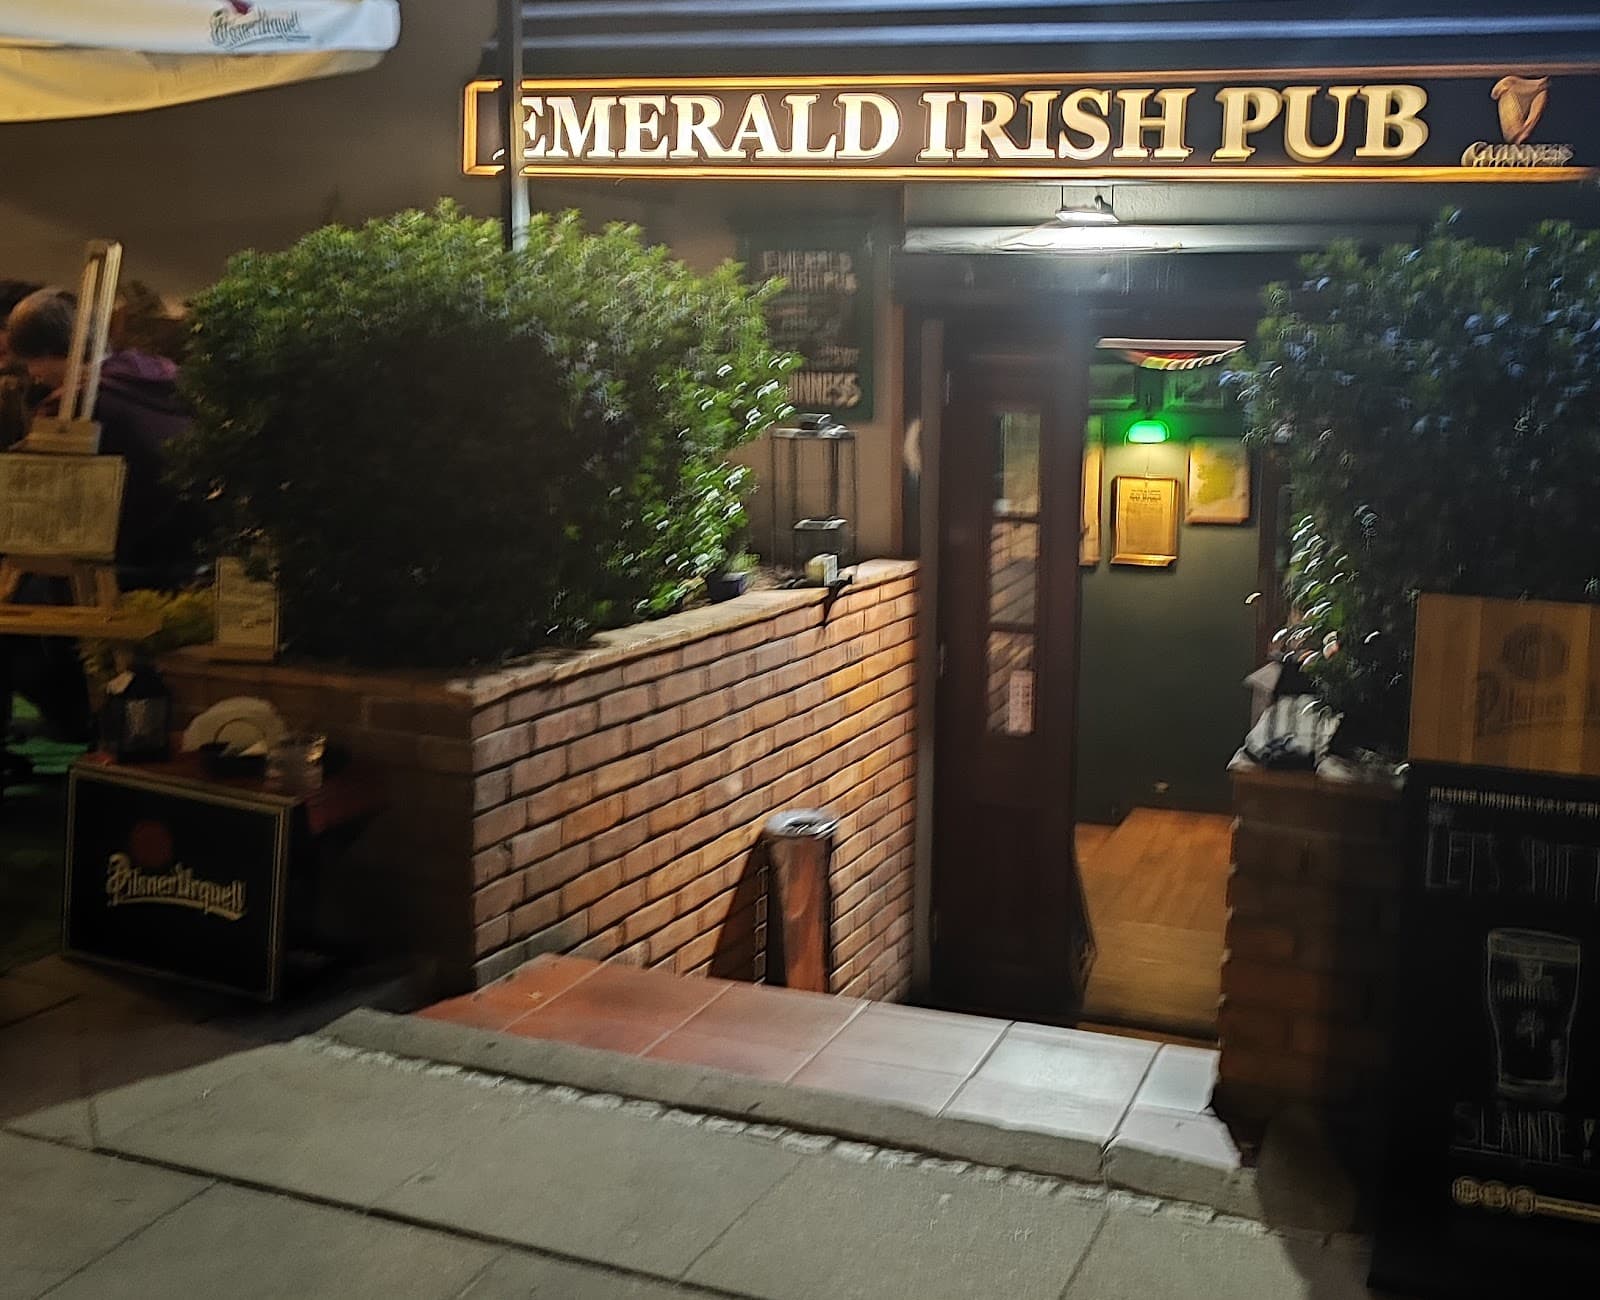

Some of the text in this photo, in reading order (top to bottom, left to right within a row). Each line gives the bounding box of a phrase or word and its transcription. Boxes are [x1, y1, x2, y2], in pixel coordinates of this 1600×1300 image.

[493, 83, 1430, 163] EMERALD IRISH PUB
[787, 371, 862, 408] INNESS
